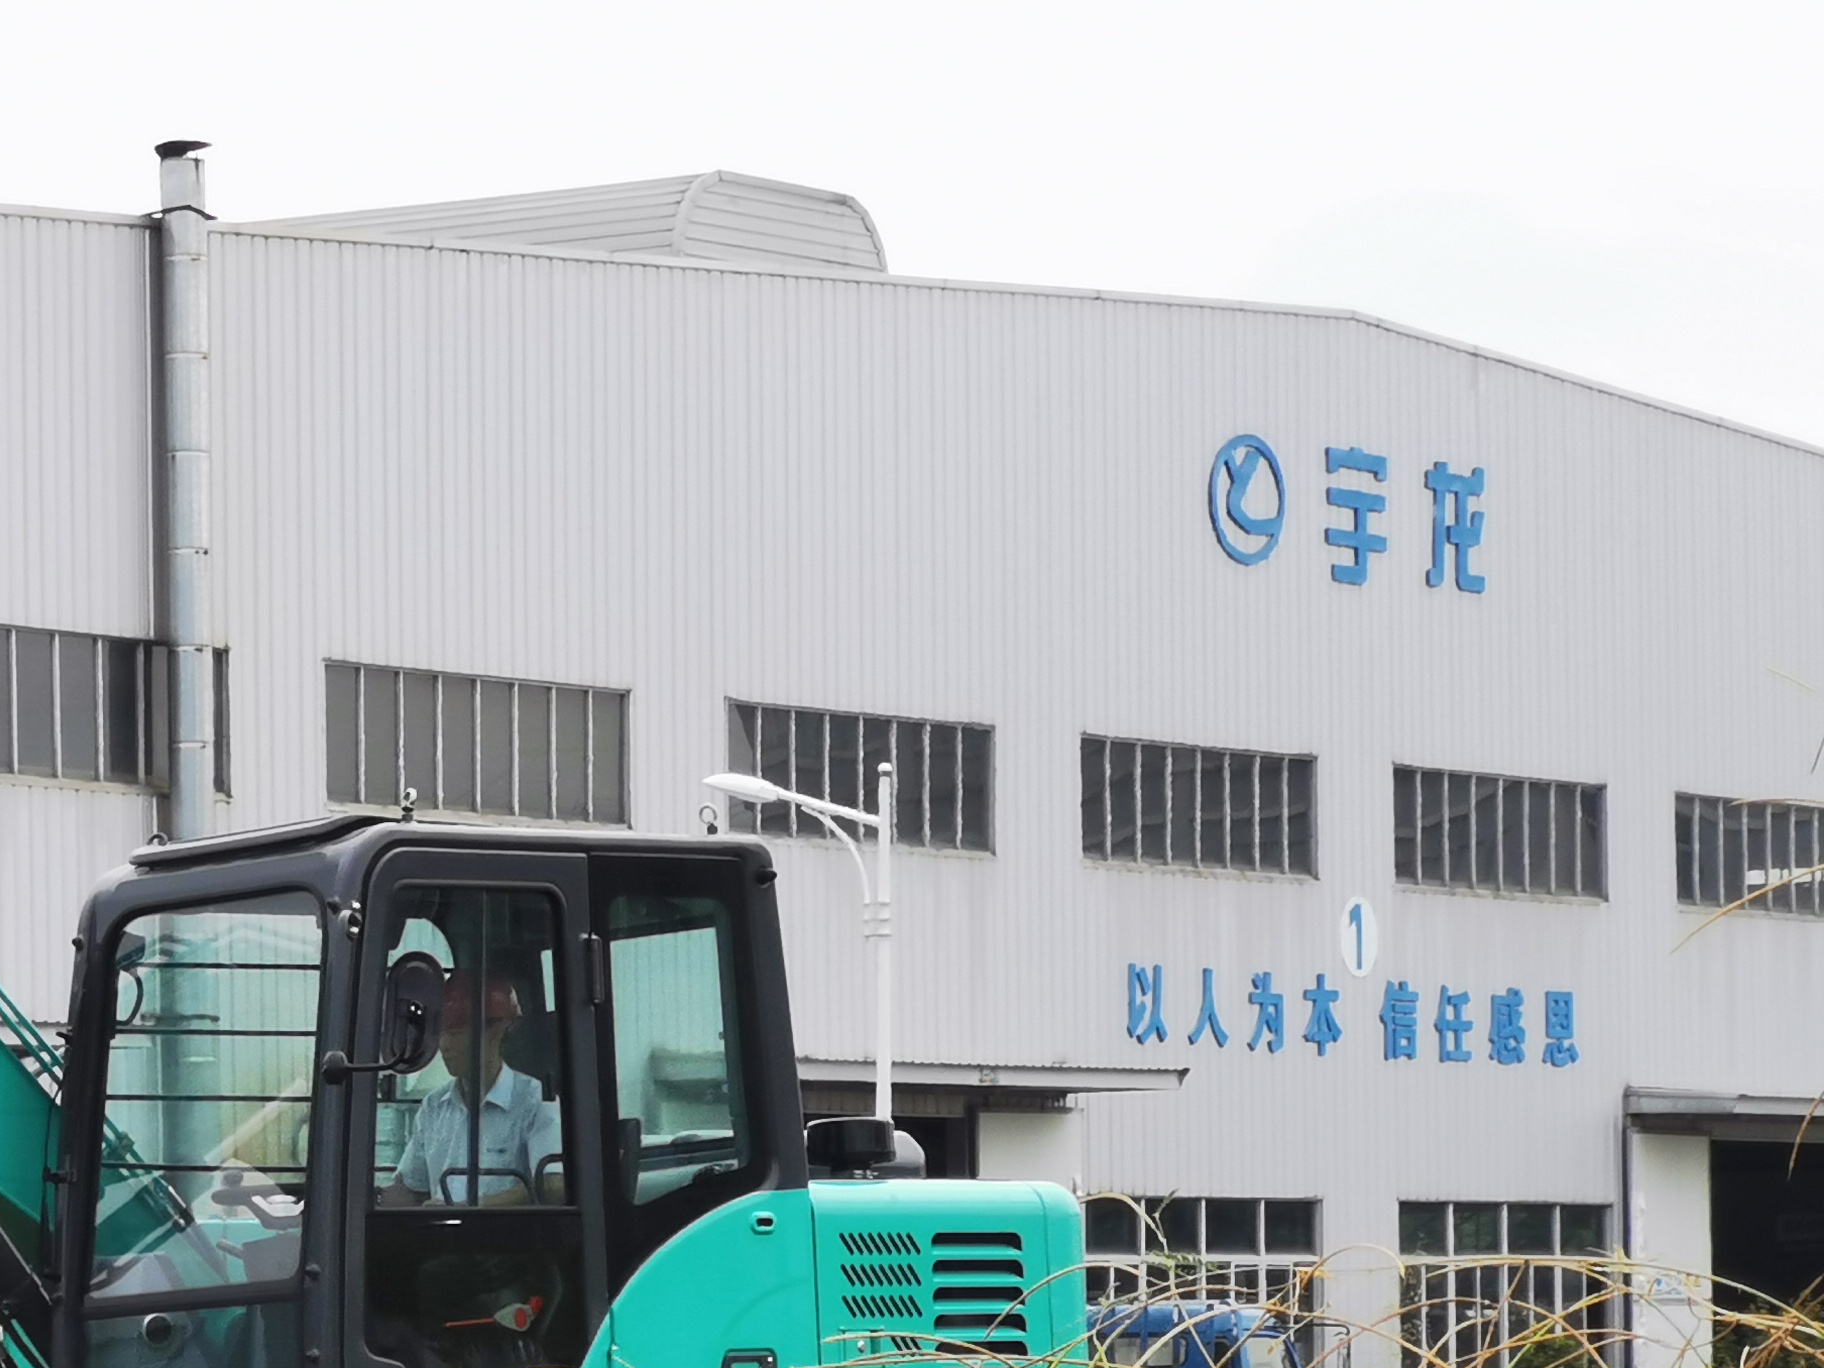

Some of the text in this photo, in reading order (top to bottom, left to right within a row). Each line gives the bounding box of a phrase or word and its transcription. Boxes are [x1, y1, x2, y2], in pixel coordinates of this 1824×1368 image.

[1324, 446, 1486, 594] 宇龙
[1349, 903, 1363, 971] 1
[1126, 962, 1580, 1068] 以人为本 信任感恩
